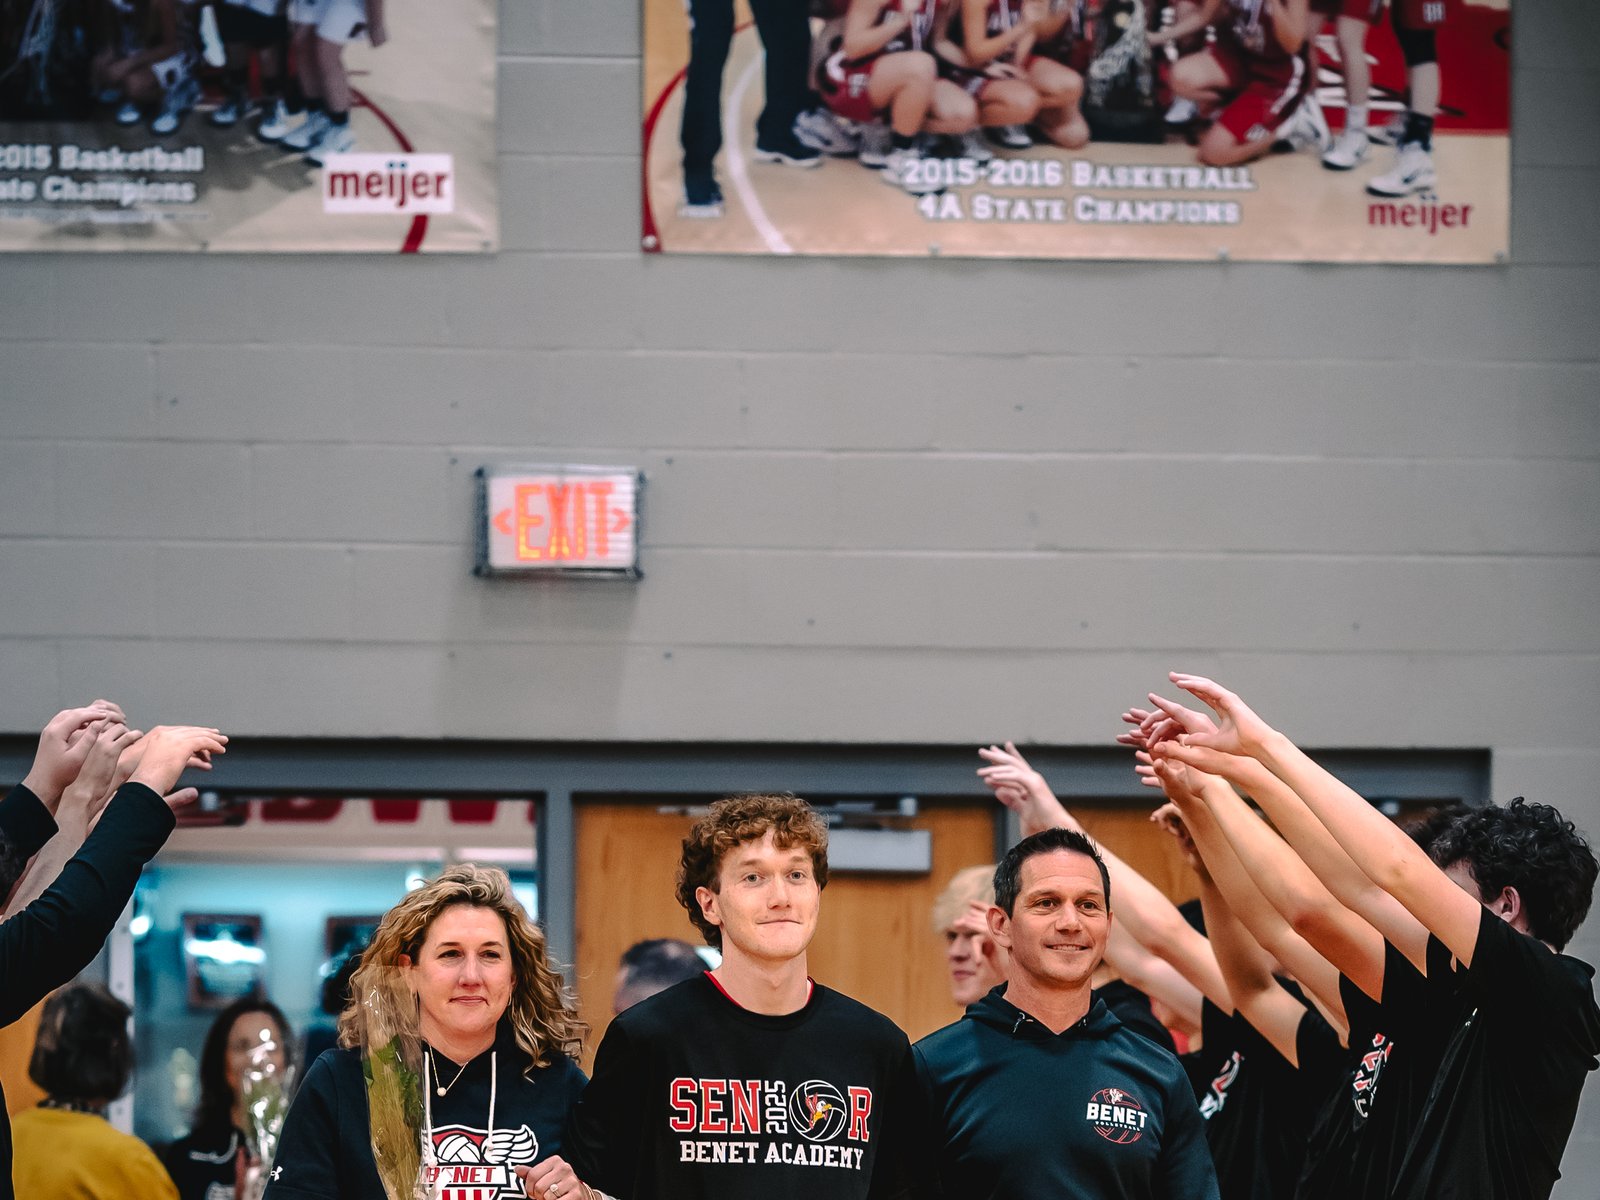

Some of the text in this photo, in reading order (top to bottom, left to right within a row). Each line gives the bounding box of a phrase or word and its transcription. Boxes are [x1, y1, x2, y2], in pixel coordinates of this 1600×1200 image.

[59, 144, 204, 172] Basketball
[904, 157, 1063, 187] 2015-2016
[42, 175, 196, 208] Champions
[329, 162, 446, 207] meijer
[918, 192, 965, 220] 4A
[1368, 194, 1474, 235] meijer
[515, 481, 614, 561] EXIT
[764, 1079, 789, 1135] 2025
[1086, 1102, 1148, 1129] BENET
[1094, 1120, 1141, 1132] VOLLEYBALL
[679, 1140, 864, 1170] BENET ACADEMY
